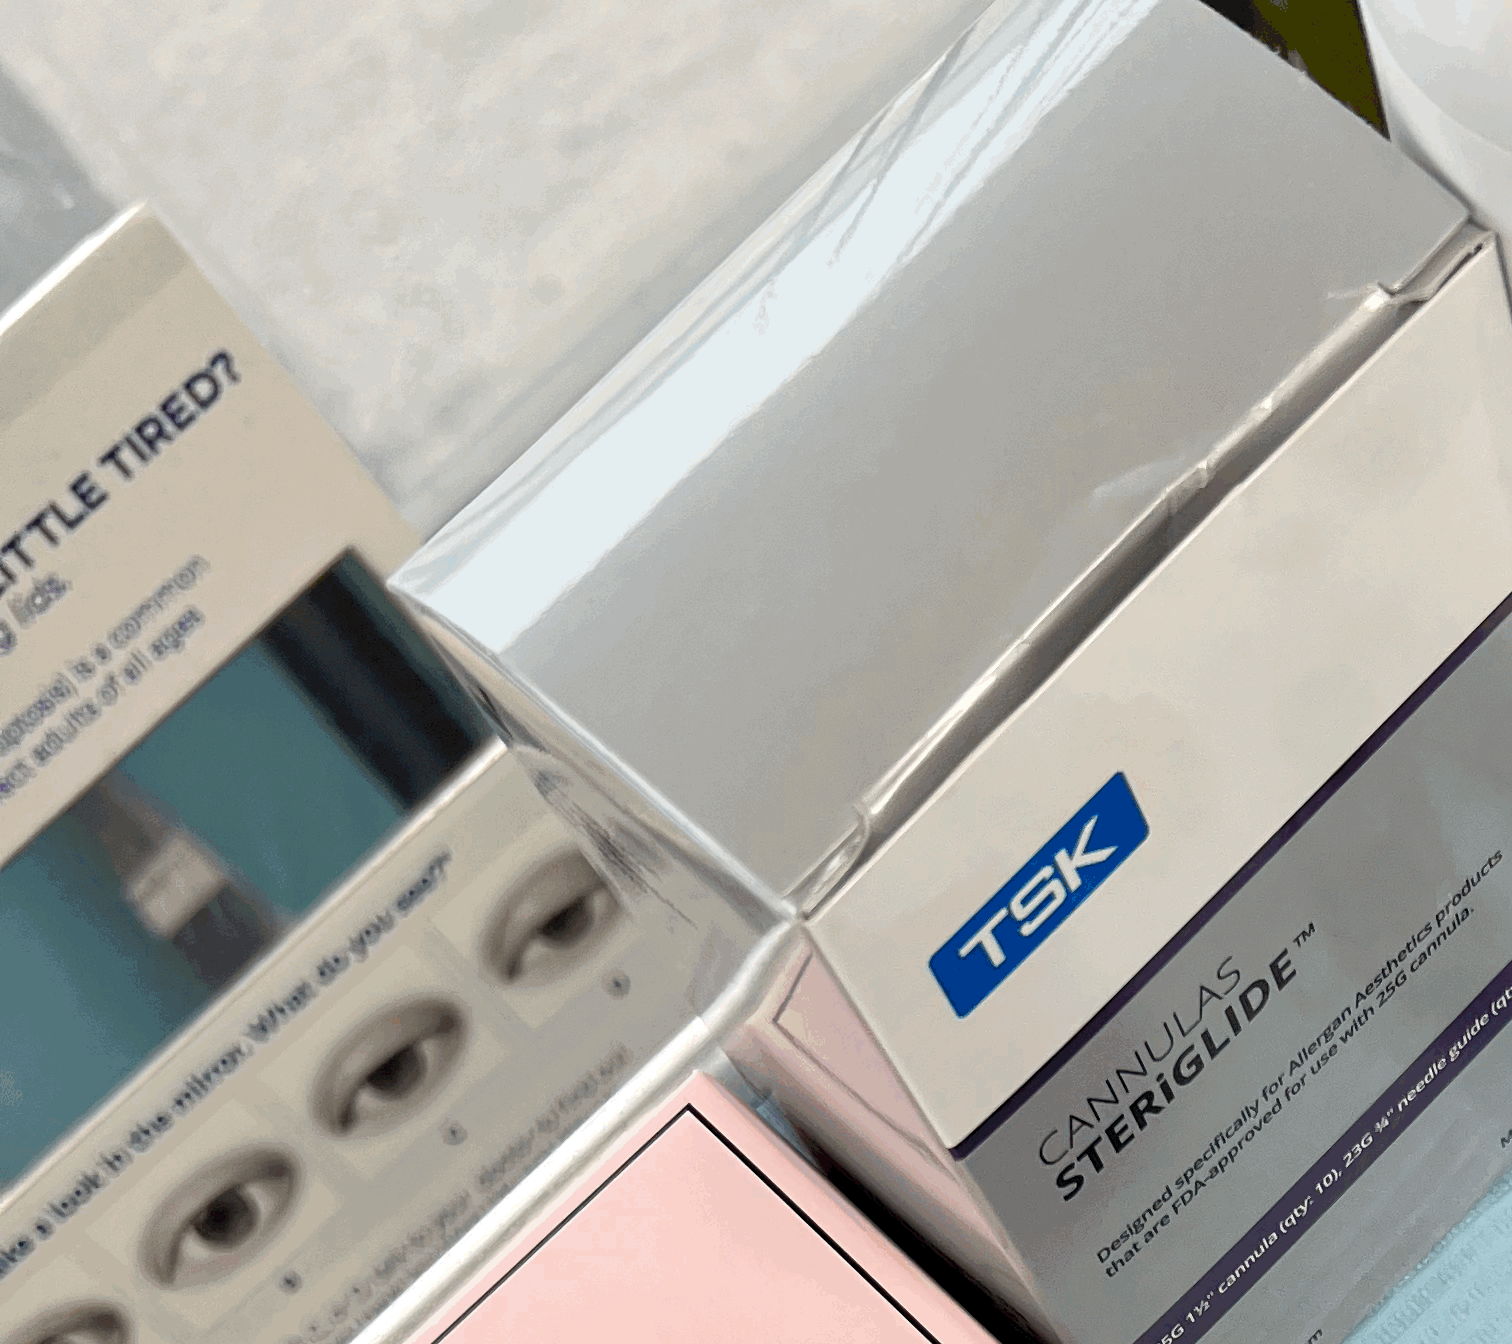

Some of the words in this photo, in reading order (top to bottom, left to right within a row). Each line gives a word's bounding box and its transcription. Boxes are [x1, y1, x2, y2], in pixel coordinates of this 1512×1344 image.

[0, 470, 109, 598] ITTLE
[100, 349, 241, 481] TIRED?
[958, 813, 1119, 969] TSK
[1038, 956, 1244, 1167] CANNULAS
[1097, 1185, 1173, 1263] Designed
[1175, 1099, 1259, 1190] specifically
[1262, 1074, 1286, 1101] for
[1289, 1006, 1351, 1077] Allergan
[1356, 921, 1432, 1008] Aesthetics
[1435, 850, 1503, 927] products
[1105, 1241, 1142, 1278] that
[1144, 1214, 1171, 1244] are
[1172, 1098, 1282, 1215] FDA-approved
[1285, 1074, 1307, 1101] for
[1310, 1044, 1338, 1075] use
[1339, 1006, 1375, 1044] with
[1376, 970, 1408, 1008] 25G
[1410, 907, 1474, 973] cannula.
[1218, 1231, 1277, 1294] cannula
[1279, 1196, 1313, 1234] (qty:
[1315, 1168, 1342, 1194] 10),
[1343, 1132, 1374, 1167] 23G
[1397, 1058, 1446, 1112] needle
[1449, 1014, 1489, 1062] guide
